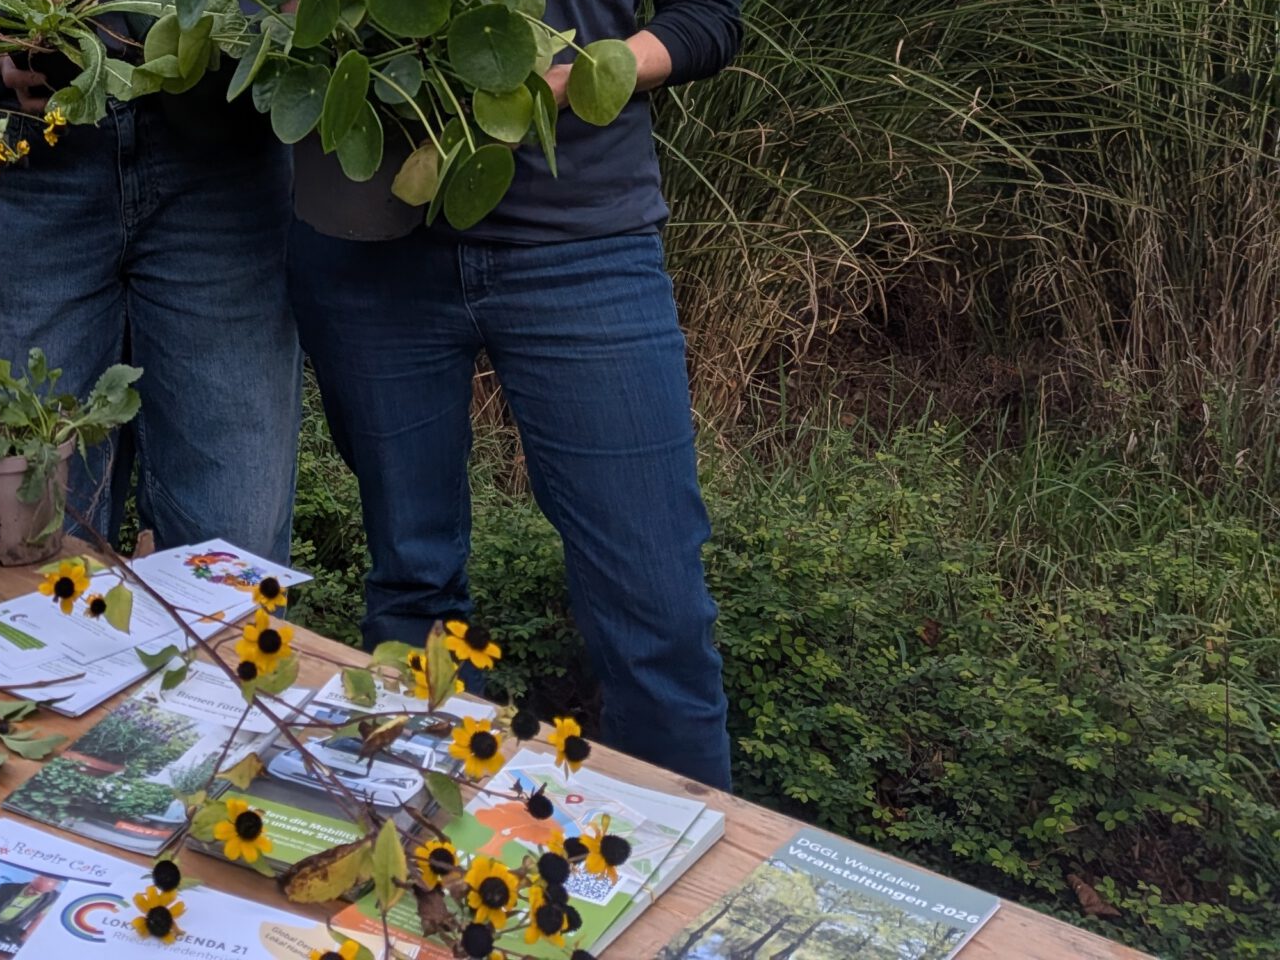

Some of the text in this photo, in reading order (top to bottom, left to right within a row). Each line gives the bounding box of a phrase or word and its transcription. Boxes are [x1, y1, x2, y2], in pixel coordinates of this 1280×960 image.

[271, 820, 315, 837] unserer
[289, 817, 308, 827] die
[308, 822, 358, 842] Mobilitä
[12, 841, 109, 877] Repair Café
[796, 838, 921, 893] DGGL Westfalen
[788, 845, 981, 925] Veranstaltungen 2026
[174, 931, 226, 952] GENDA
[231, 943, 249, 956] 21
